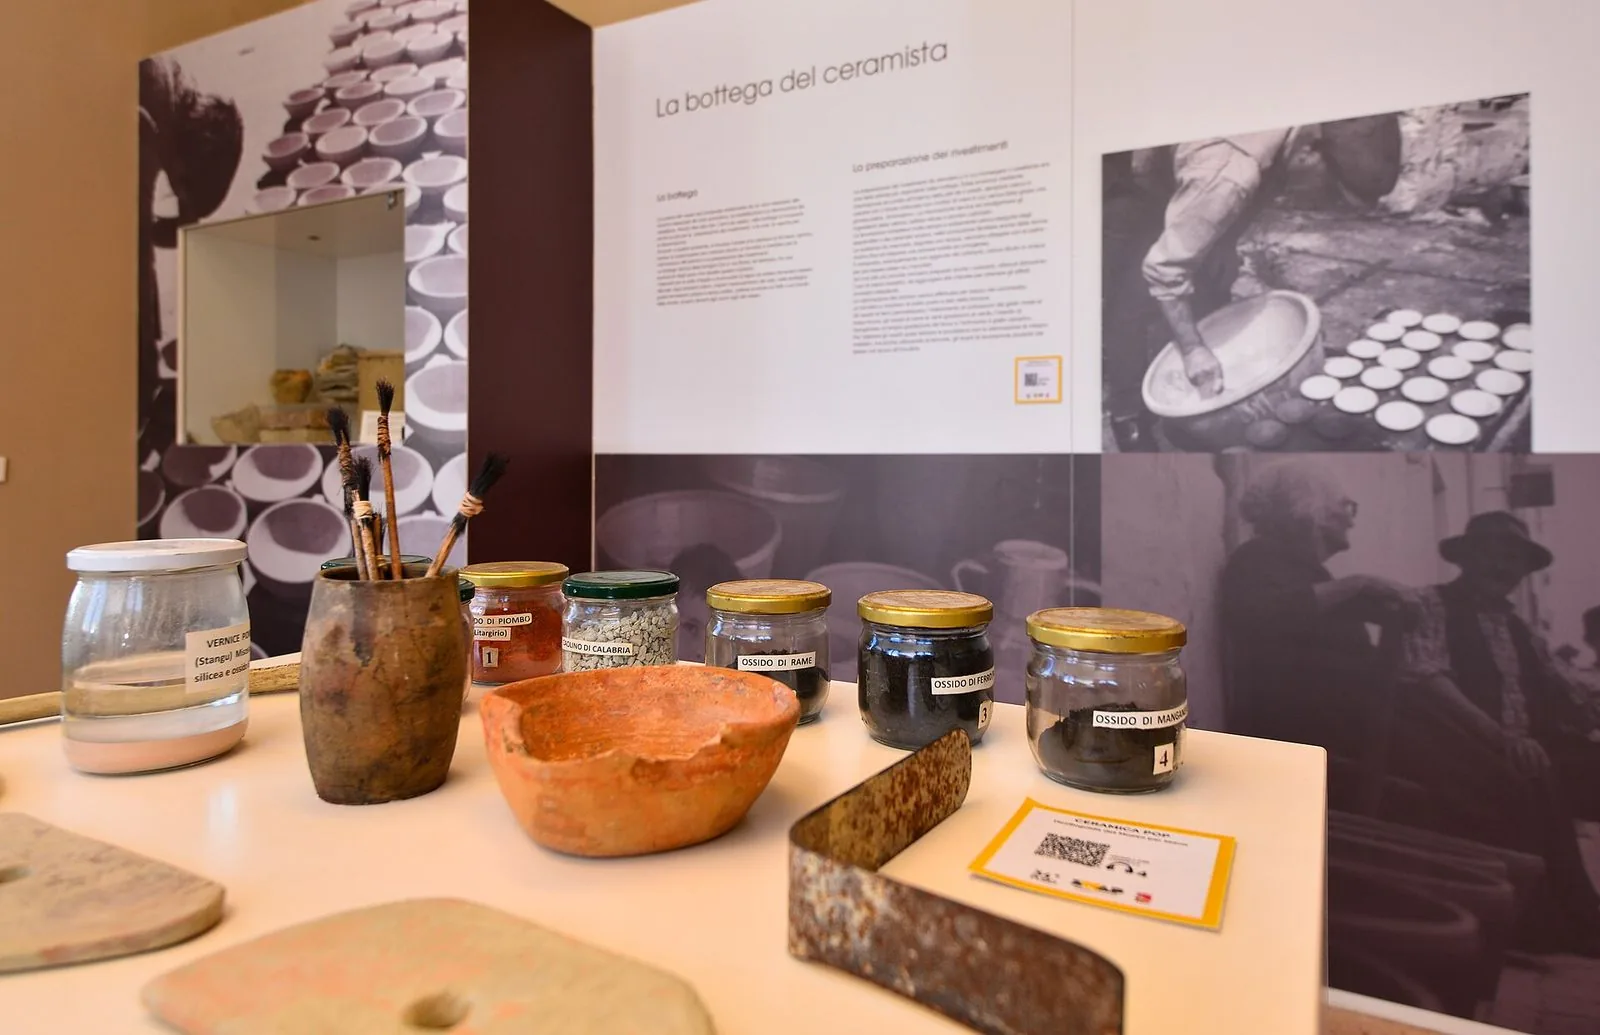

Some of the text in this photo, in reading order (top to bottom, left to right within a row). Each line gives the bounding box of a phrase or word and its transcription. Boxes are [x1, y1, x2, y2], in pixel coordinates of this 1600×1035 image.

[656, 41, 949, 118] La bottega del ceramista
[487, 617, 494, 625] DI
[498, 615, 531, 625] PIOMBO
[206, 634, 240, 648] VERNICE
[583, 644, 591, 652] DI
[592, 646, 631, 654] CALABRIA
[195, 651, 233, 668] (Stangu)
[486, 652, 492, 664] 1
[742, 657, 812, 667] OSSIDO DI RAME
[194, 670, 224, 683] silicea
[934, 679, 967, 689] OSSIDO
[968, 678, 976, 686] DI
[981, 707, 988, 723] 3
[1095, 714, 1137, 725] OSSIDO
[1142, 716, 1152, 725] DI
[1159, 750, 1168, 767] 4
[1074, 818, 1140, 833] CERAMICA
[1143, 829, 1170, 838] POP
